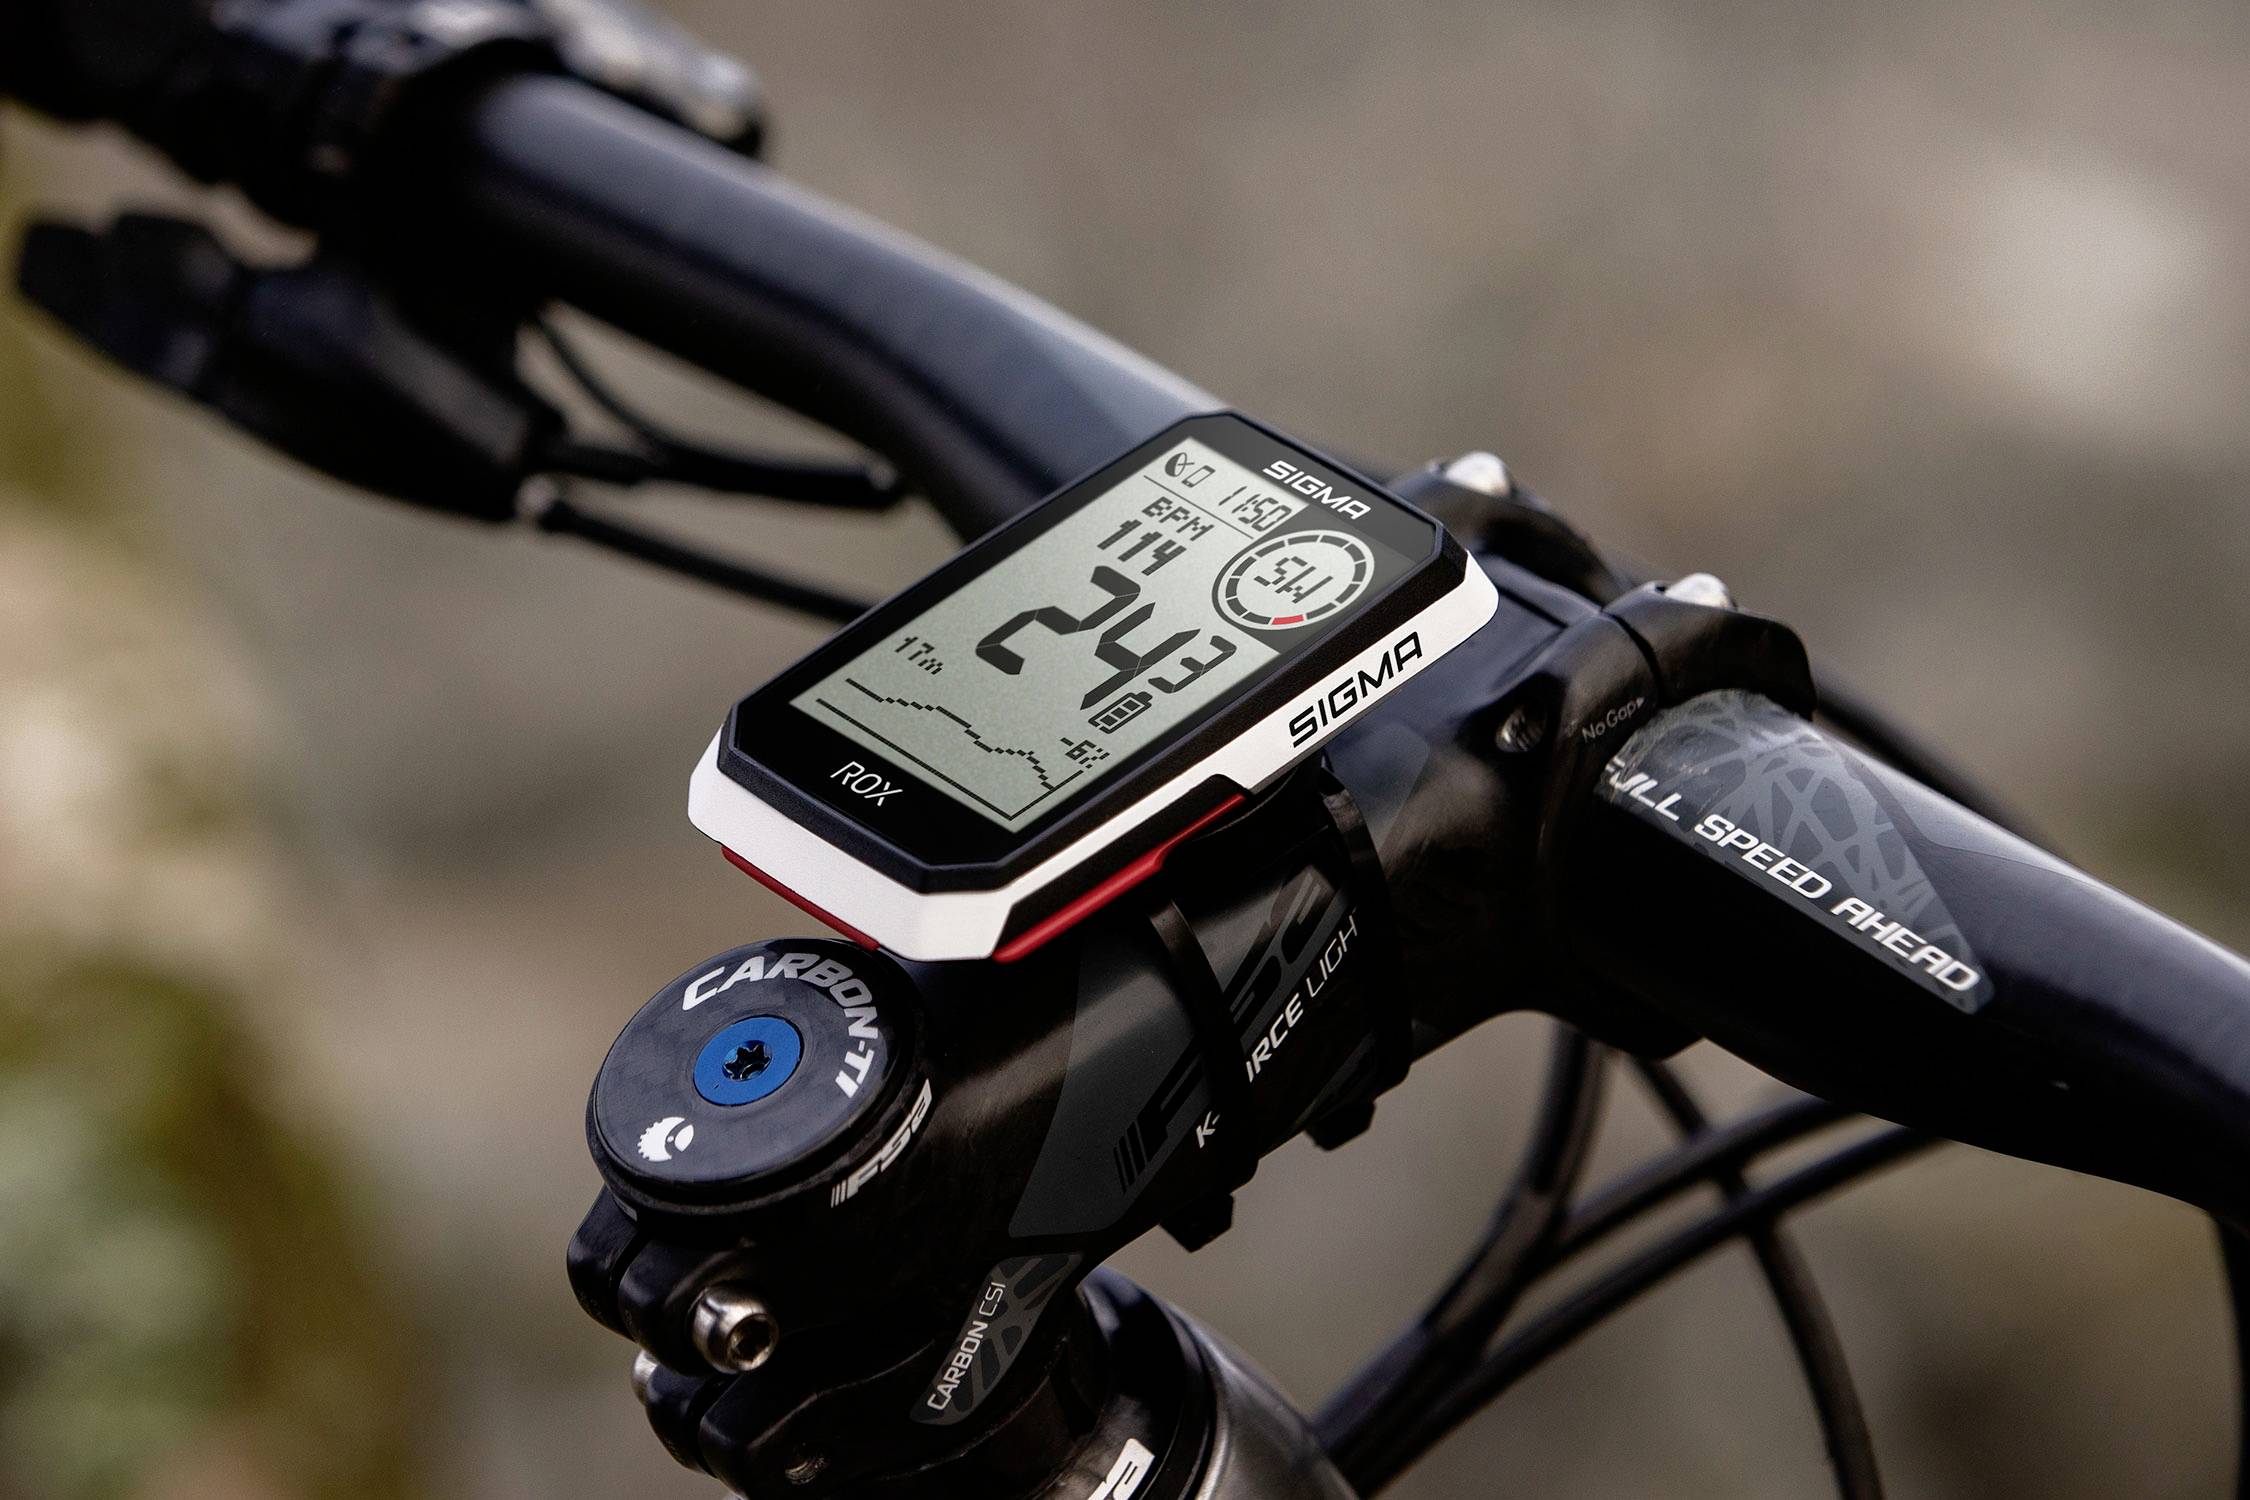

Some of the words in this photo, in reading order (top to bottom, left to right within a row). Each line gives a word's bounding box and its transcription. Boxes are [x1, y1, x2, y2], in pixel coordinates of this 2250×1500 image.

[1141, 496, 1214, 541] BPM
[1262, 460, 1371, 520] SIGMA
[1097, 519, 1187, 576] 114
[1253, 556, 1334, 603] SW
[894, 636, 944, 675] 17m
[1289, 631, 1423, 748] SIGMA
[830, 760, 903, 807] ROX
[1694, 814, 1832, 899] SPEED
[1831, 897, 1980, 992] AHEAD
[682, 952, 879, 1099] CARBON-TI
[927, 1321, 989, 1411] CARBON
[979, 1281, 1006, 1318] CSI
